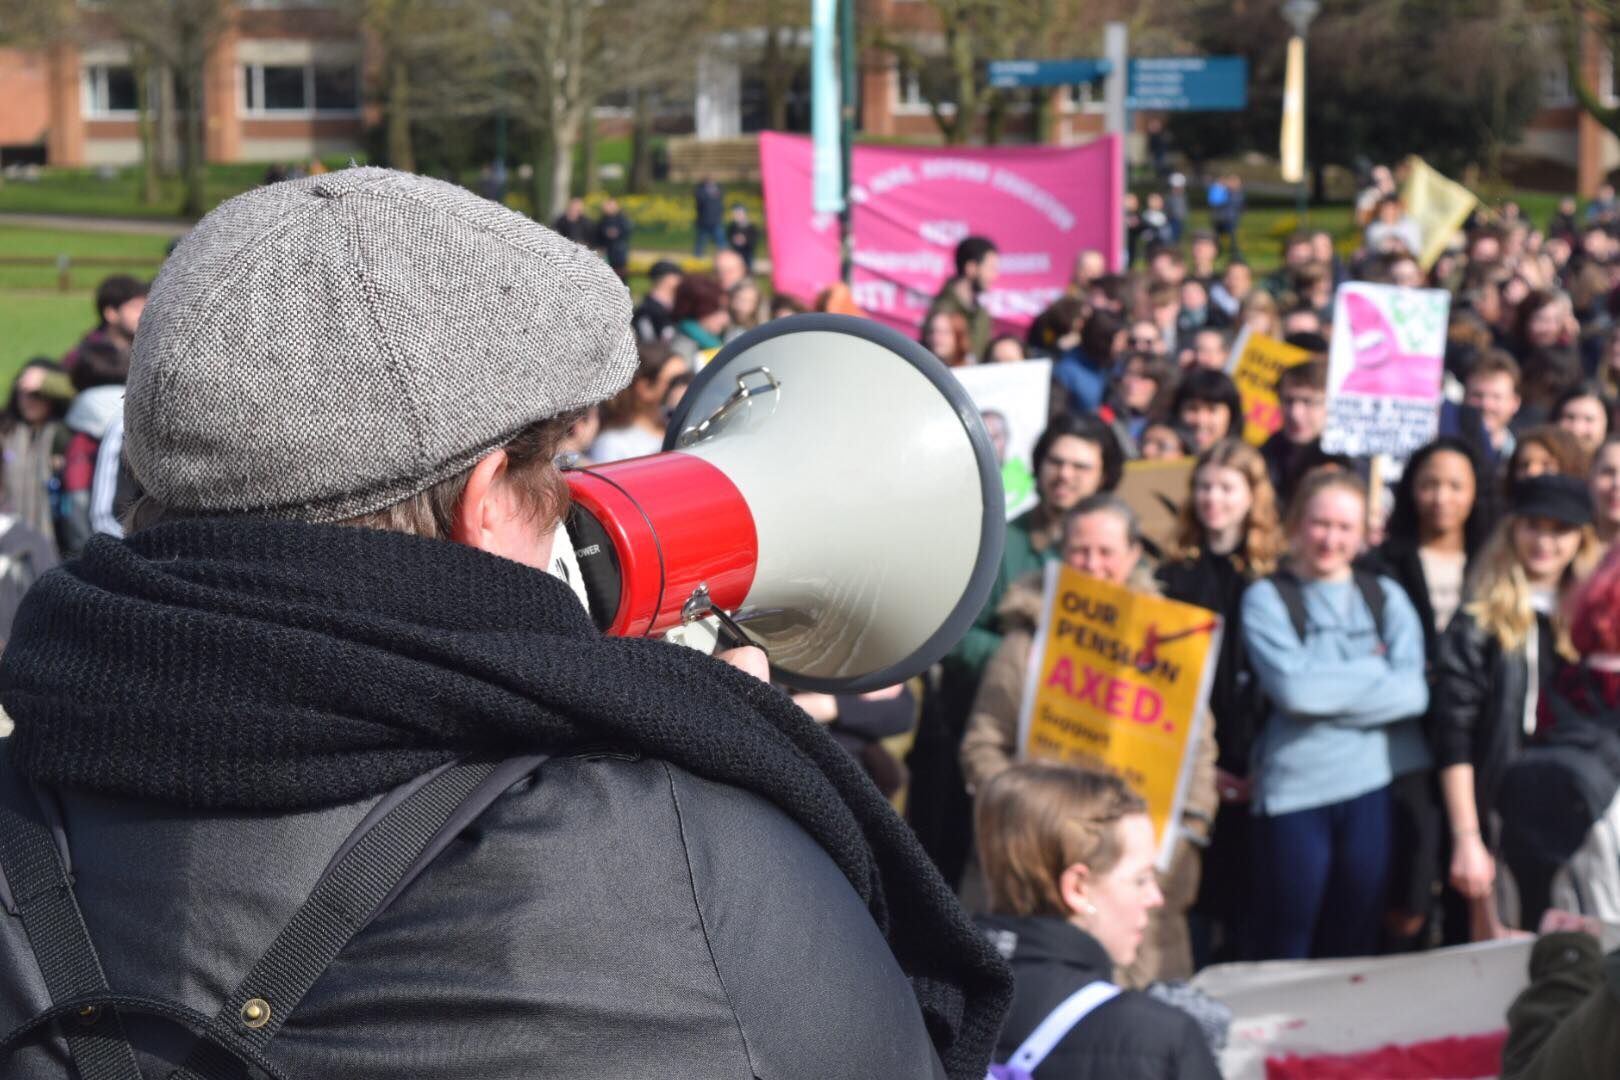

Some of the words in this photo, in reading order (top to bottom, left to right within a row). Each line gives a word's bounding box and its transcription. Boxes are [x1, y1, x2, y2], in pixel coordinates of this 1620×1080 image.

[1061, 591, 1119, 626] OUR
[1055, 618, 1181, 684] PENSION
[1047, 655, 1175, 733] AXED.
